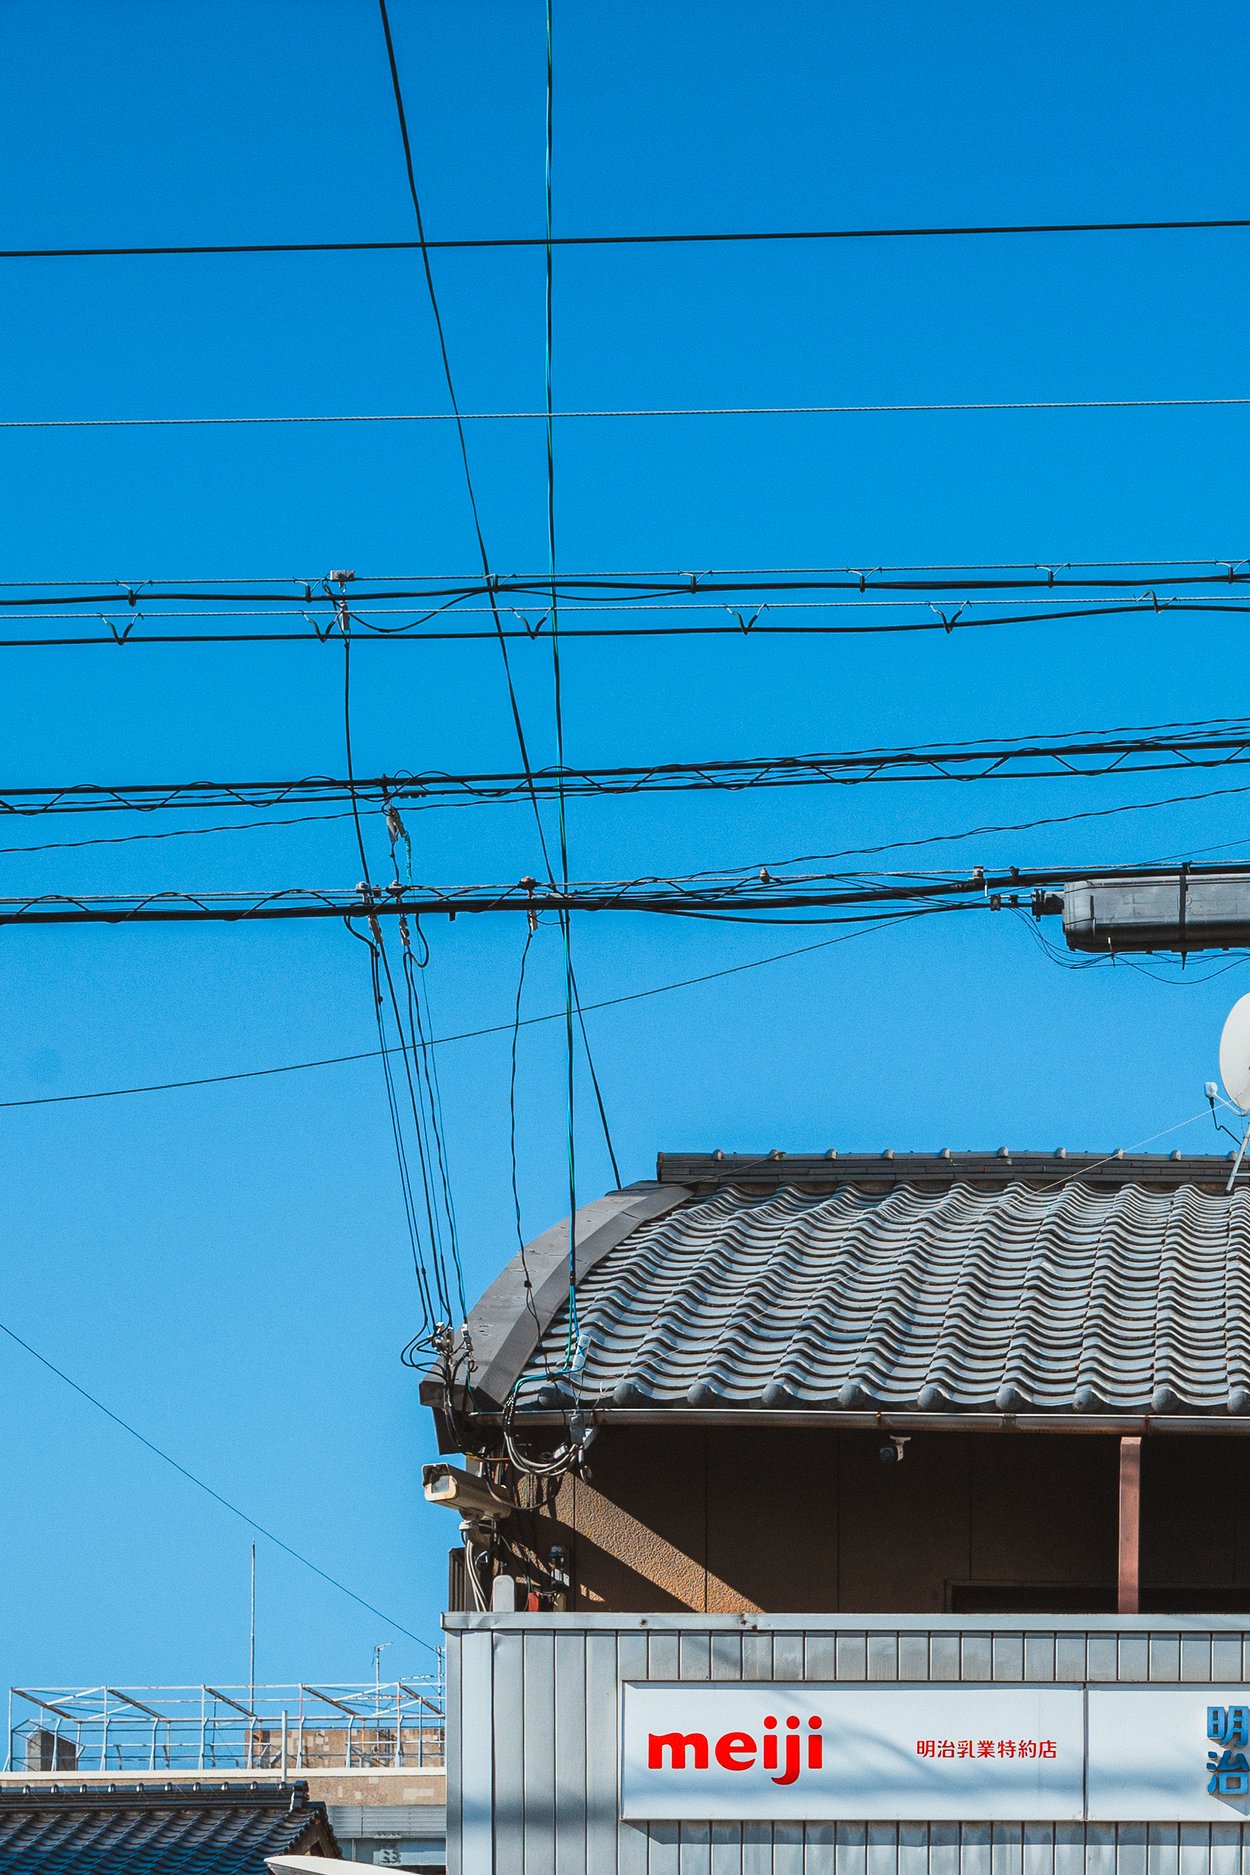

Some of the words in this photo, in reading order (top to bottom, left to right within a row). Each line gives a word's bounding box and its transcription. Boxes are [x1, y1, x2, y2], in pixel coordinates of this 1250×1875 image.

[648, 1715, 822, 1786] meiji
[916, 1739, 1057, 1759] 明治乳業特約店
[1206, 1705, 1249, 1795] 明治
